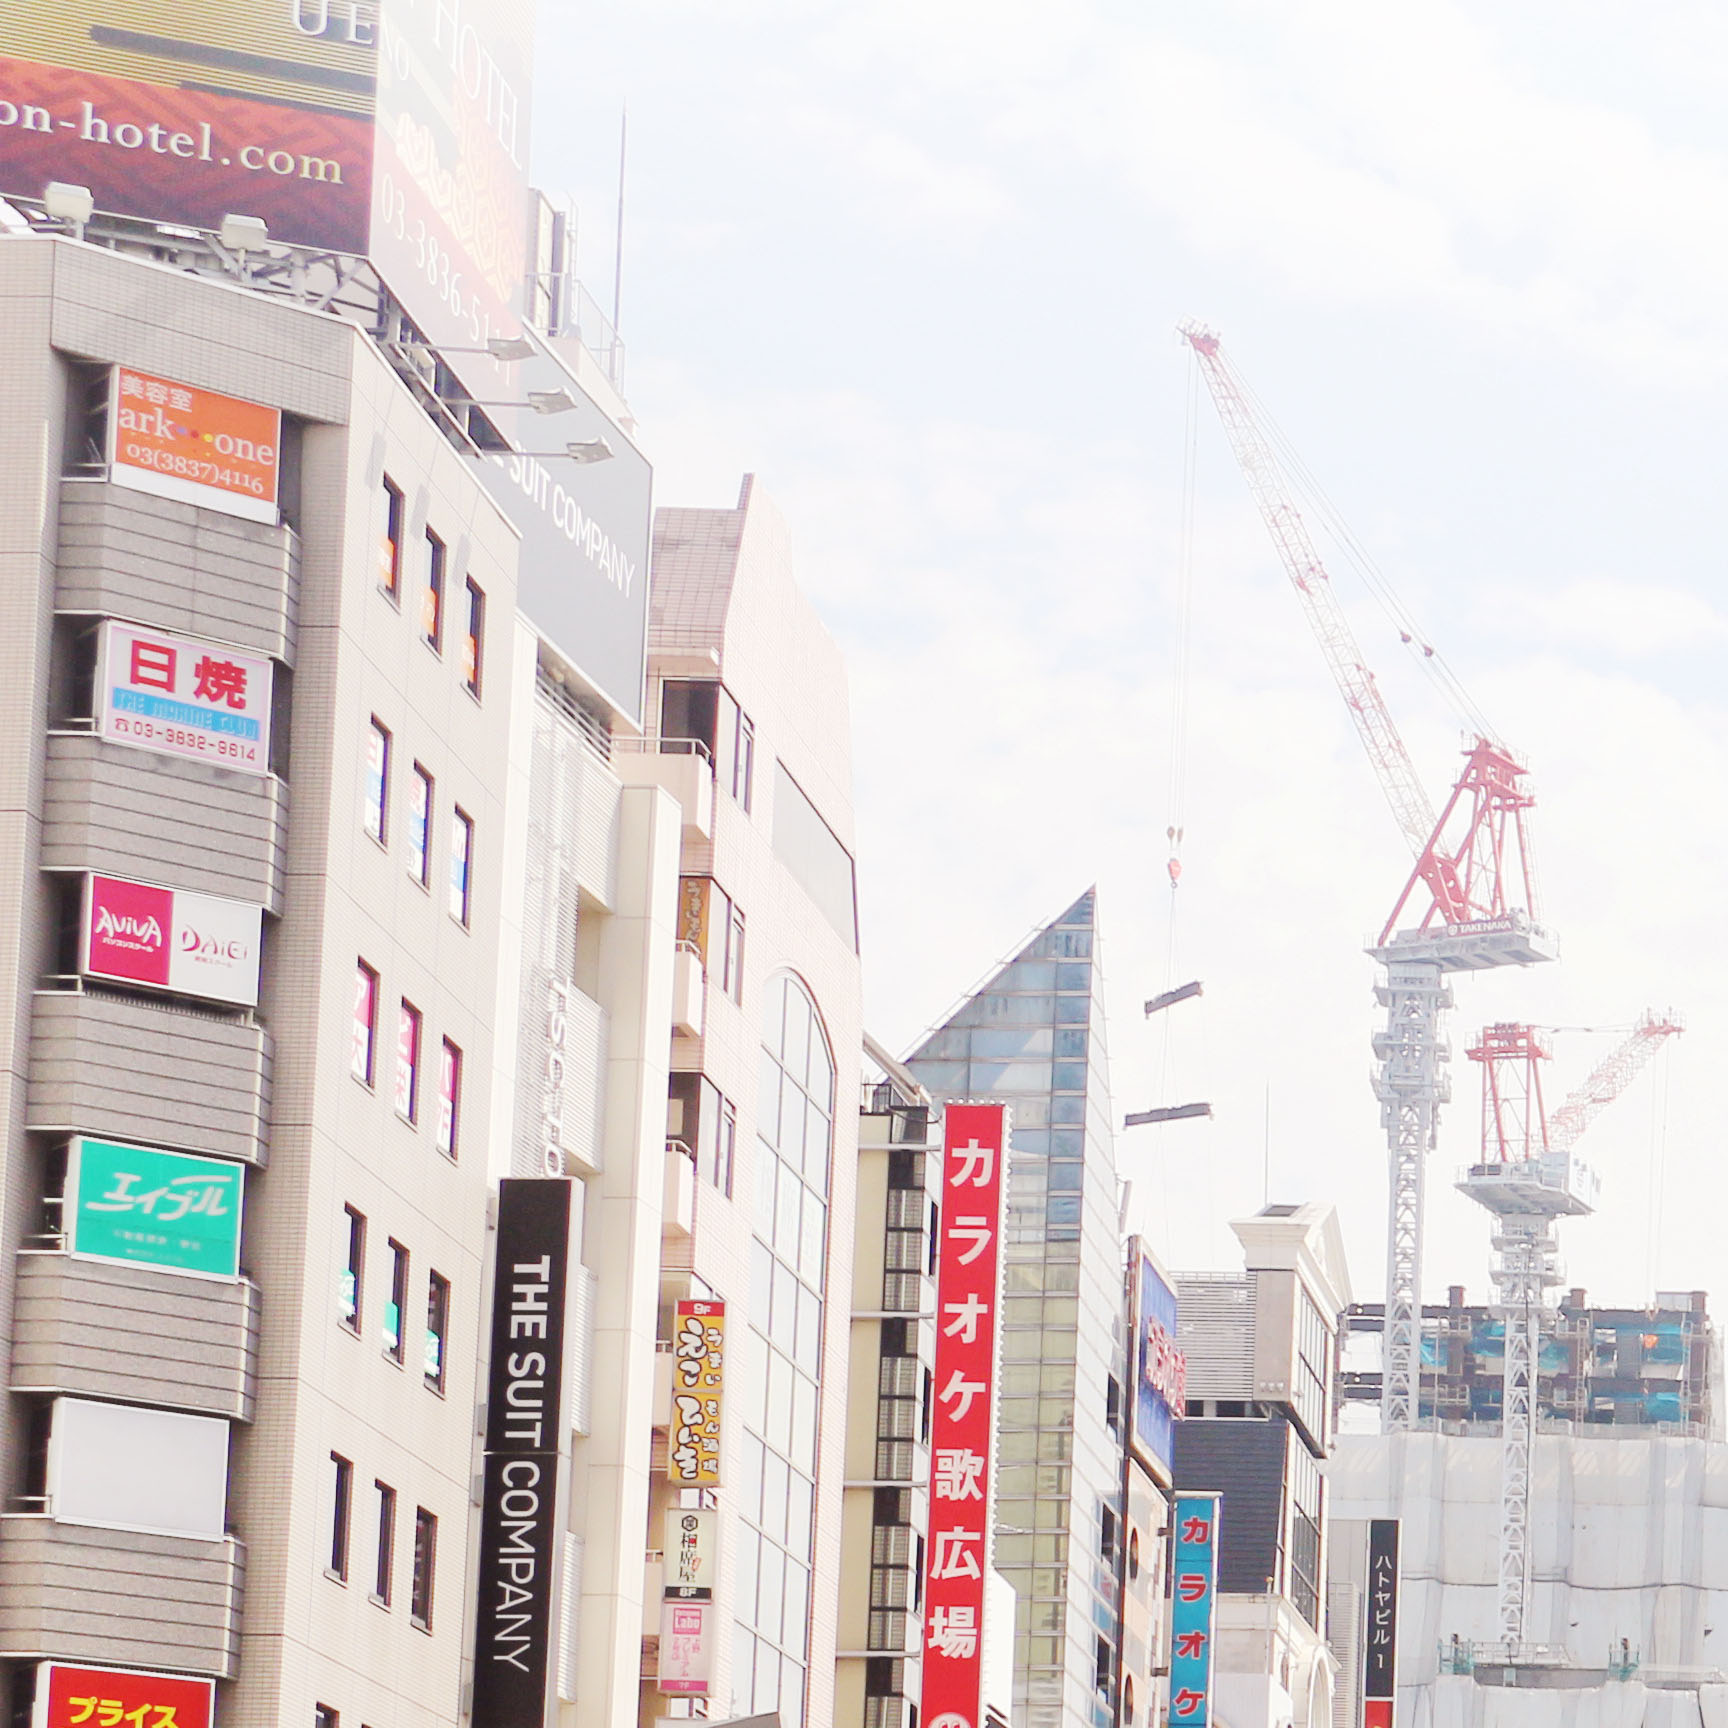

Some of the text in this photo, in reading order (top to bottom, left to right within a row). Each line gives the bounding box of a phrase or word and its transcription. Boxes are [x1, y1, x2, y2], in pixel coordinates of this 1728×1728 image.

[120, 374, 194, 413] 美容室
[126, 441, 264, 494] 03(3837)4116
[553, 484, 636, 599] COMPANY
[130, 640, 247, 710] 日焼
[85, 1172, 234, 1221] エイブル
[928, 1136, 995, 1661] カラオケ歌広場
[490, 1254, 550, 1674] THE SUIT COMPANY
